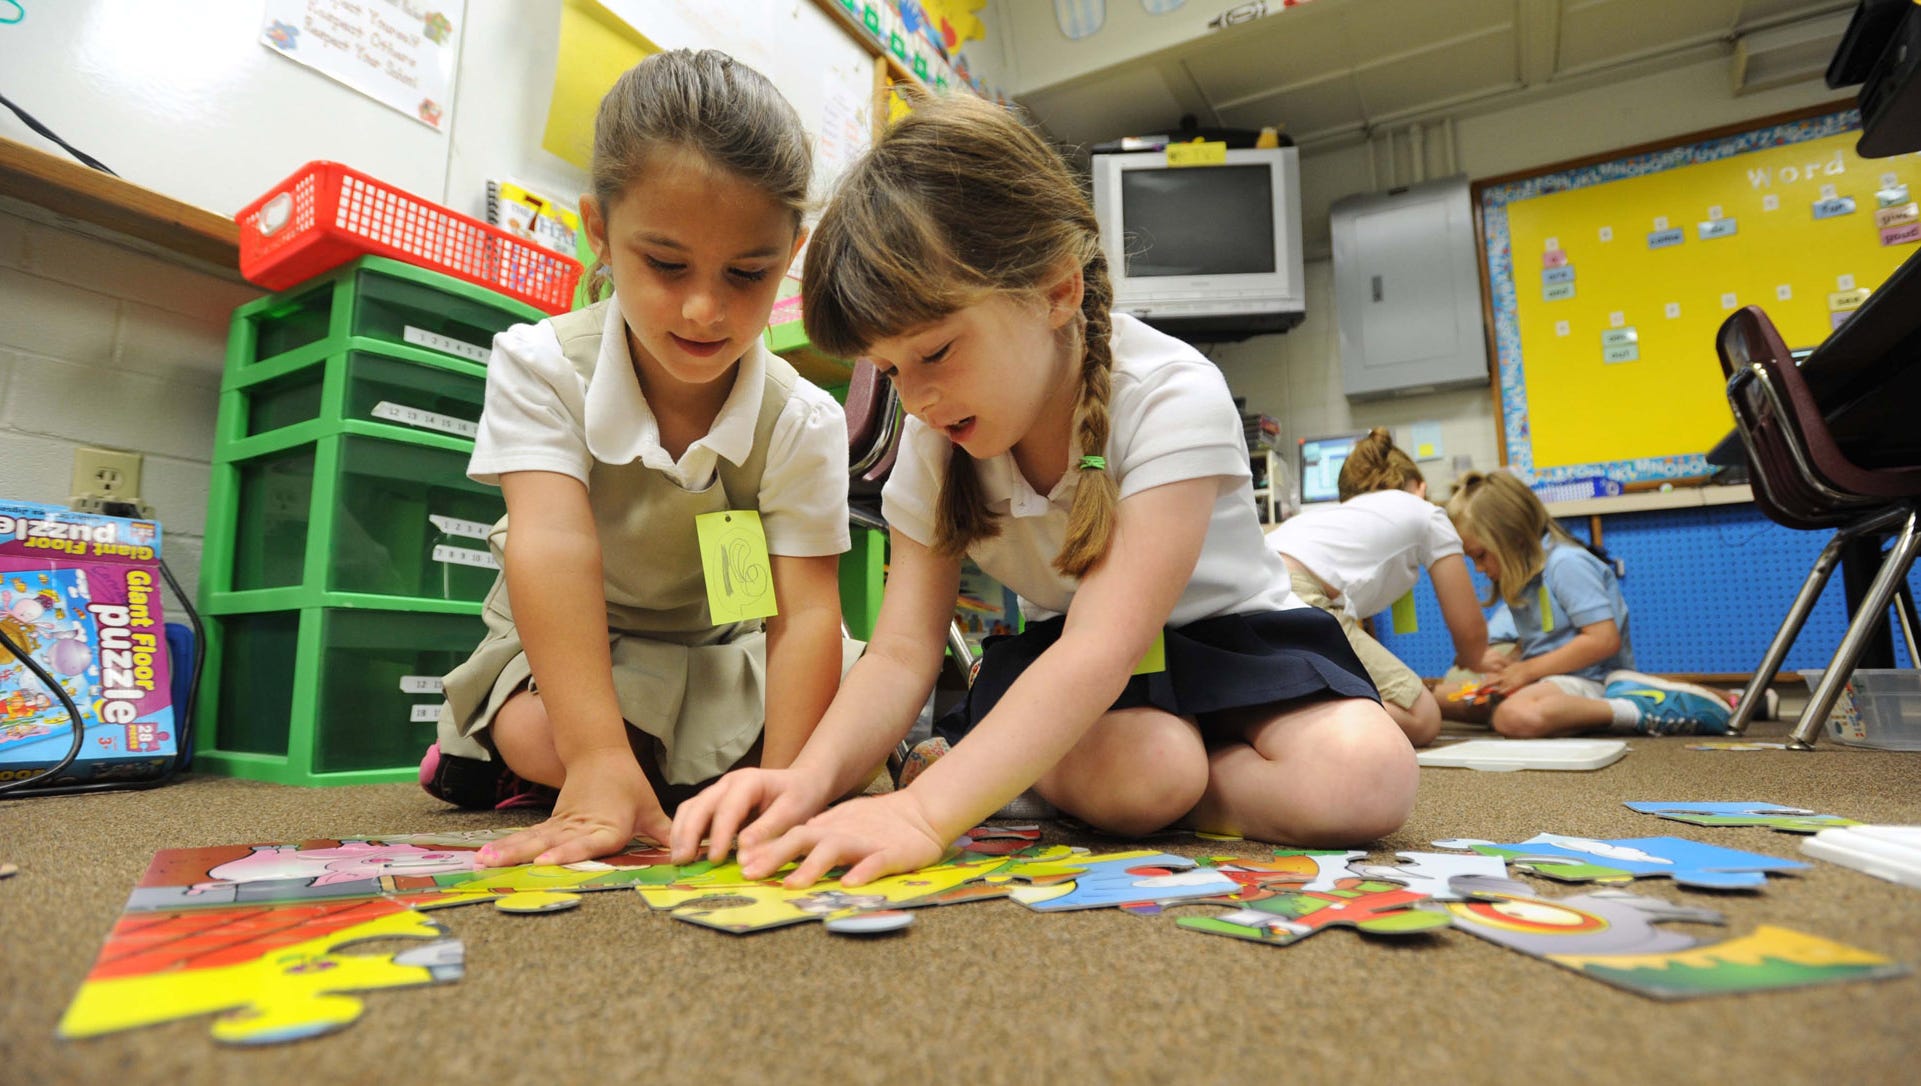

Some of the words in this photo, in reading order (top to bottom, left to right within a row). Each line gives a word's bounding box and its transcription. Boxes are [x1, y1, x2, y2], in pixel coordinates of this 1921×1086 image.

[1747, 150, 1845, 189] Word
[524, 194, 543, 232] 7
[24, 536, 87, 555] Floor
[93, 542, 154, 560] Giant
[126, 570, 155, 627] Giant
[88, 604, 145, 724] puzzle
[131, 633, 157, 691] Floor
